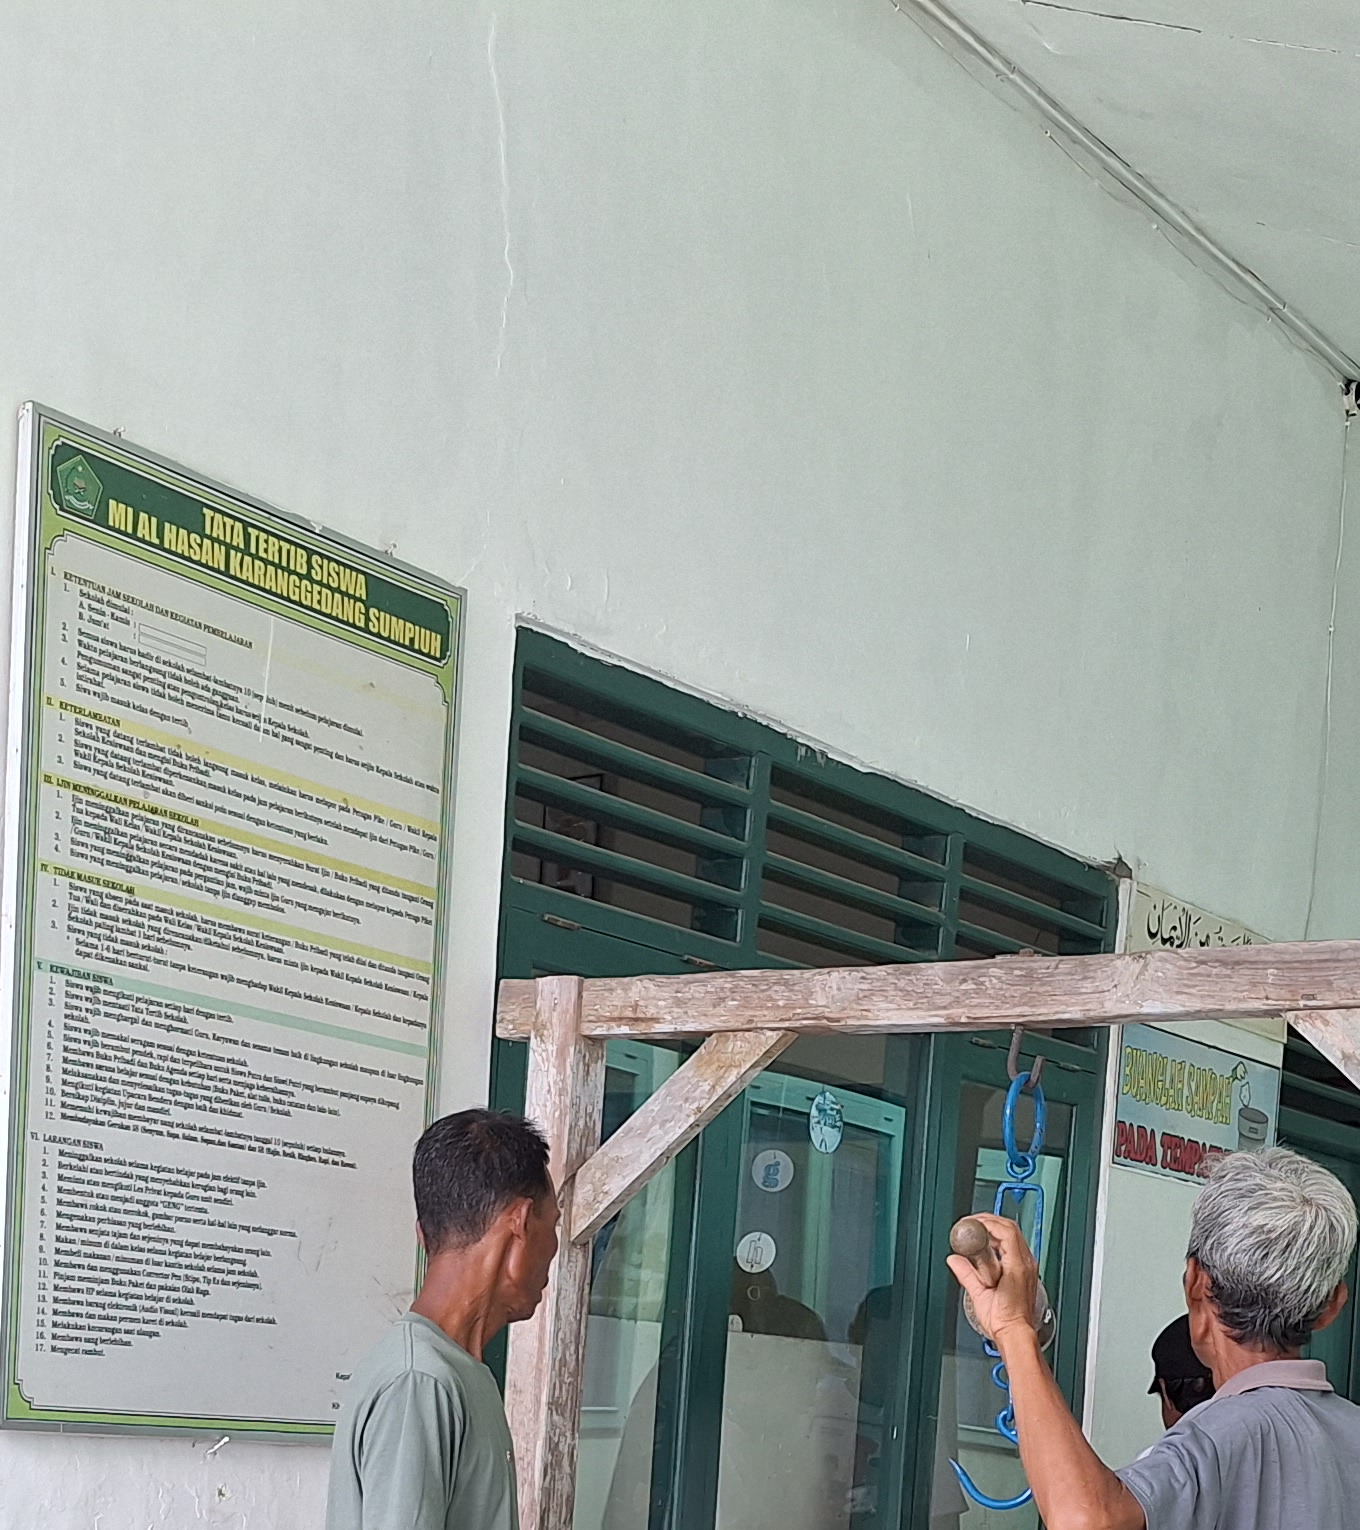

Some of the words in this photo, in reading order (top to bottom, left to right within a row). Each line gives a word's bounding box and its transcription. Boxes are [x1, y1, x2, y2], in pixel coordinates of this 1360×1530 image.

[107, 498, 134, 534] MI
[136, 510, 160, 544] AL
[163, 521, 226, 572] HASAN
[228, 552, 366, 629] KARANGGEDANG
[367, 610, 443, 659] SUMPIUH
[202, 507, 245, 549] TATA
[247, 527, 307, 575] TERTIB
[310, 554, 368, 601] SISWA
[1122, 1045, 1186, 1111] BUANGLAH
[1185, 1063, 1233, 1125] SAMPAH
[1115, 1121, 1158, 1167] PADA
